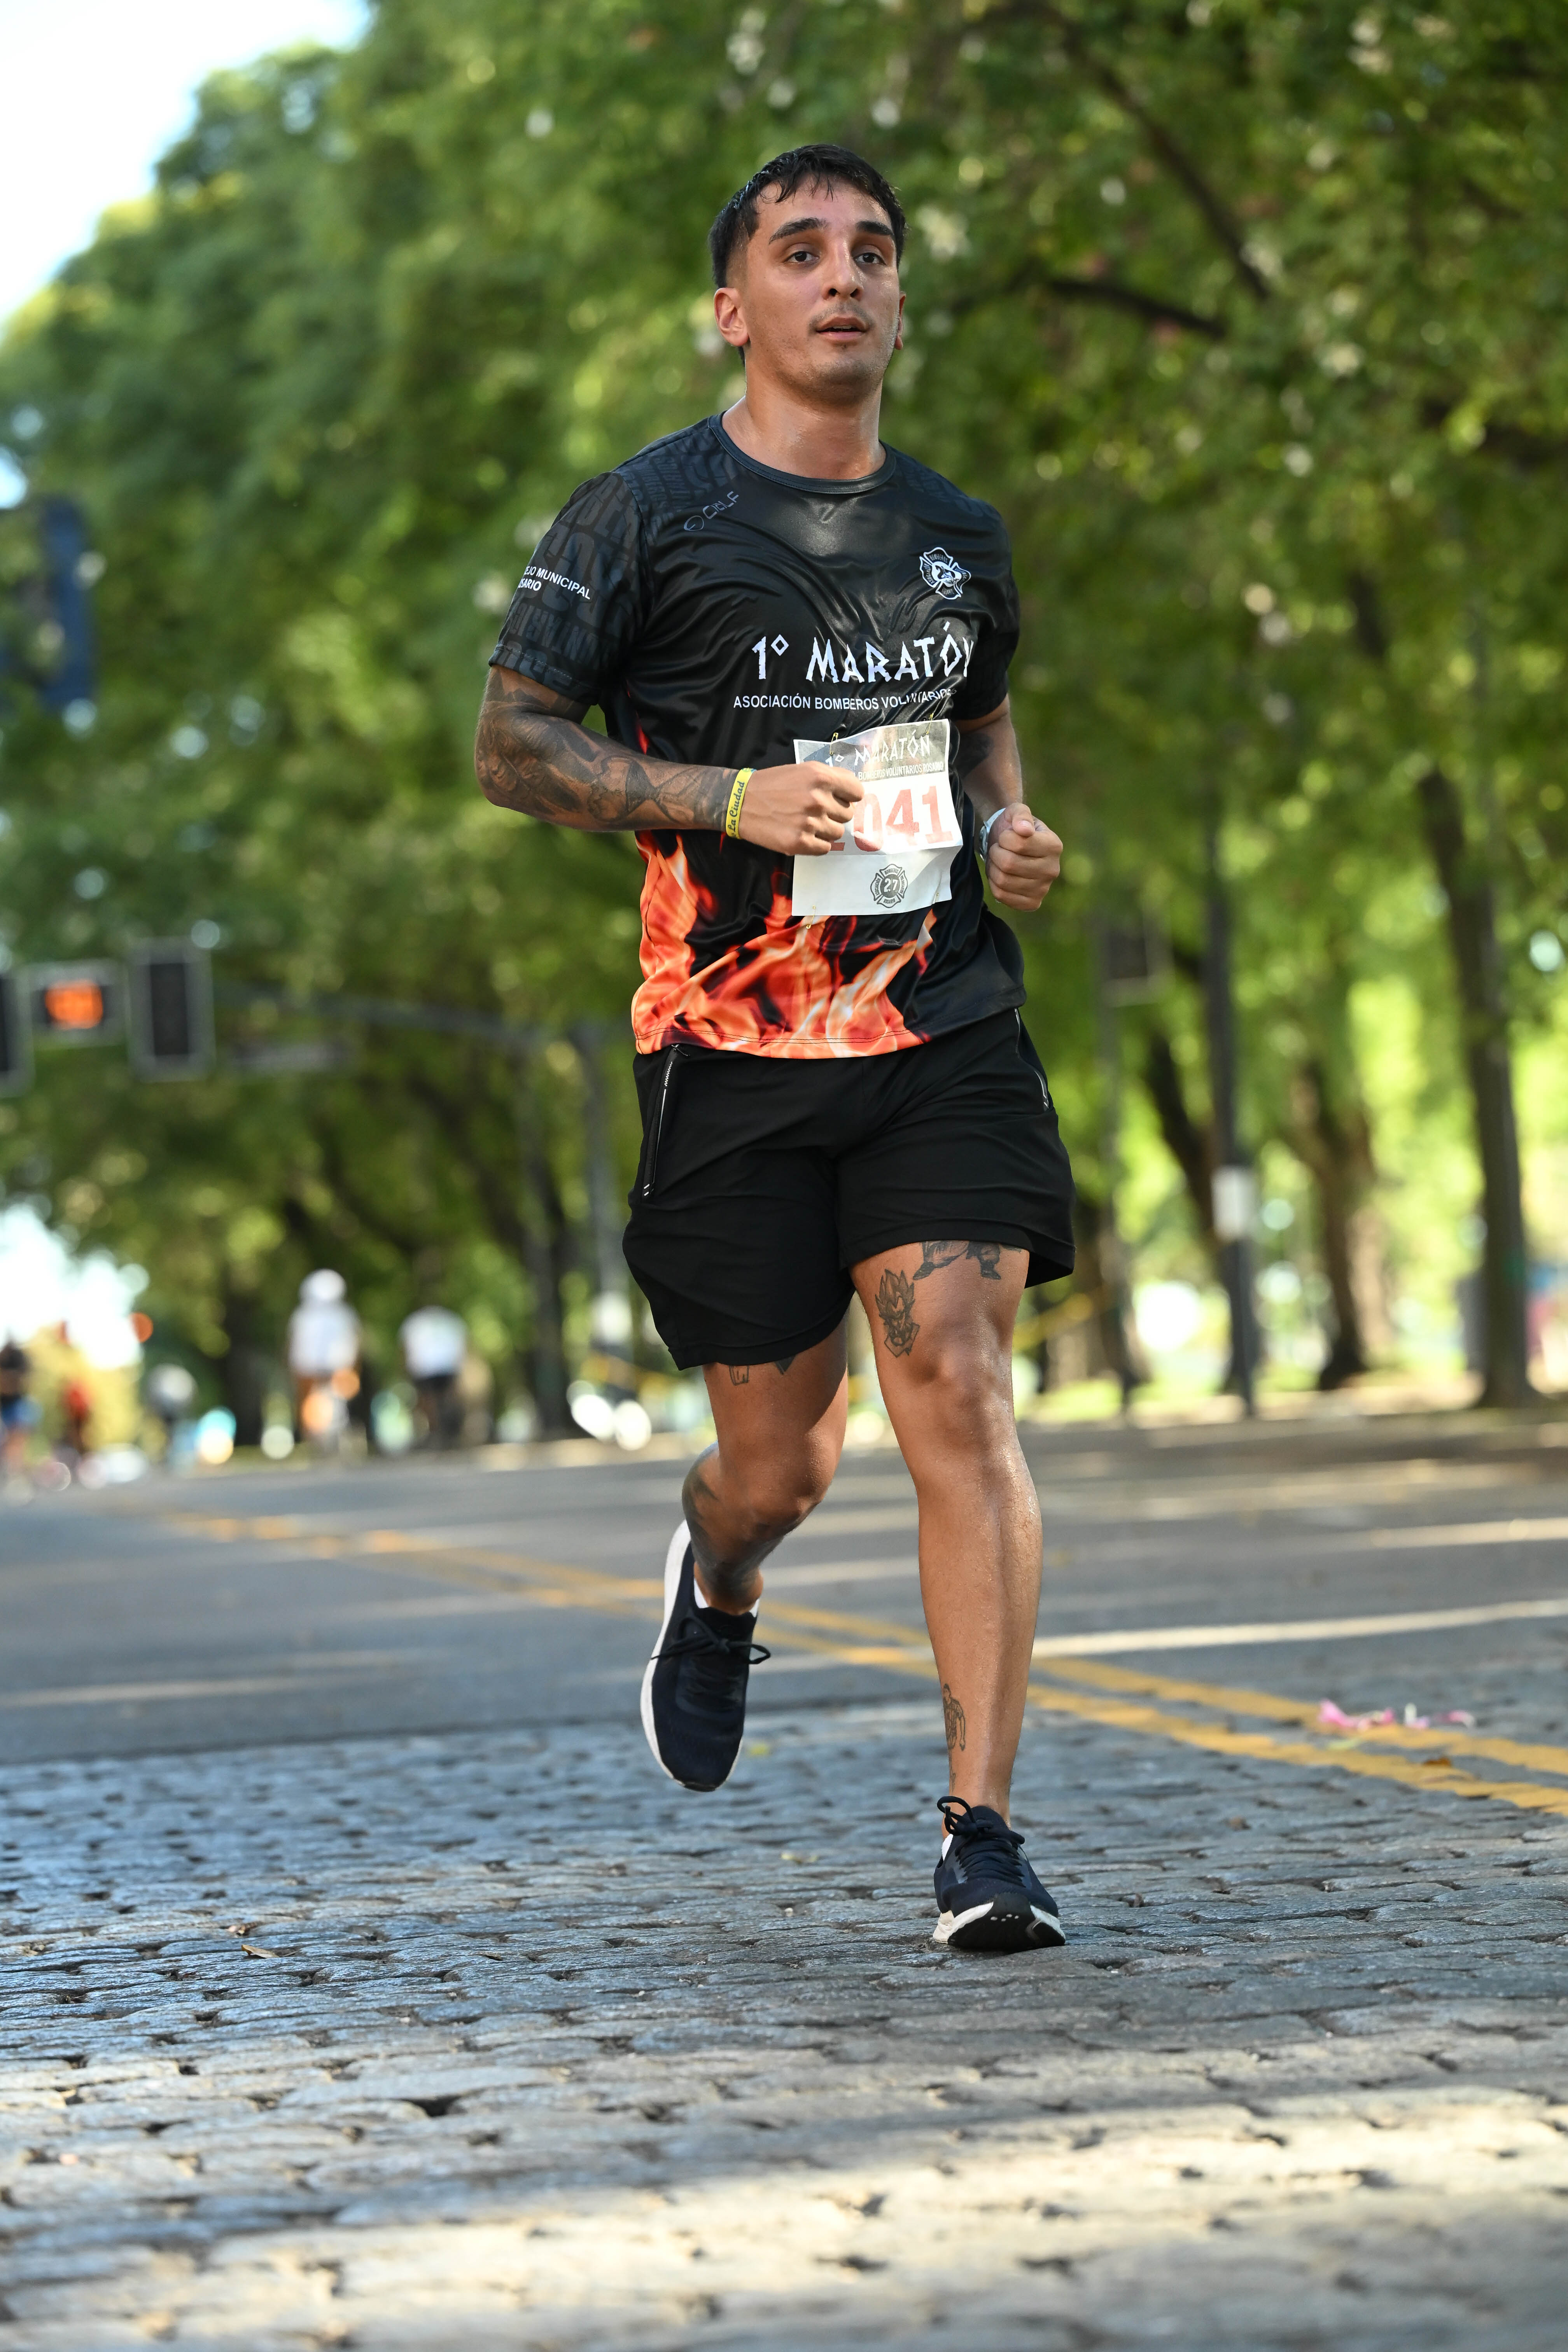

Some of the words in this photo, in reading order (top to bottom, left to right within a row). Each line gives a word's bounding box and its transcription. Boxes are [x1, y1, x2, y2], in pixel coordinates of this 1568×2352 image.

[517, 578, 542, 591] OSARIO
[536, 567, 590, 600] MUNICIPAL
[733, 693, 811, 709] ASOCIACIÓN
[815, 696, 879, 710] BOMBEROS
[854, 730, 931, 766] MARATÓN
[858, 769, 885, 780] BOMBEROS
[886, 764, 922, 777] VOLUNTARIOS
[922, 761, 944, 773] ROSARIO
[729, 780, 745, 817] Ciudad
[727, 819, 737, 831] La
[830, 786, 954, 852] 041
[884, 878, 898, 892] 27
